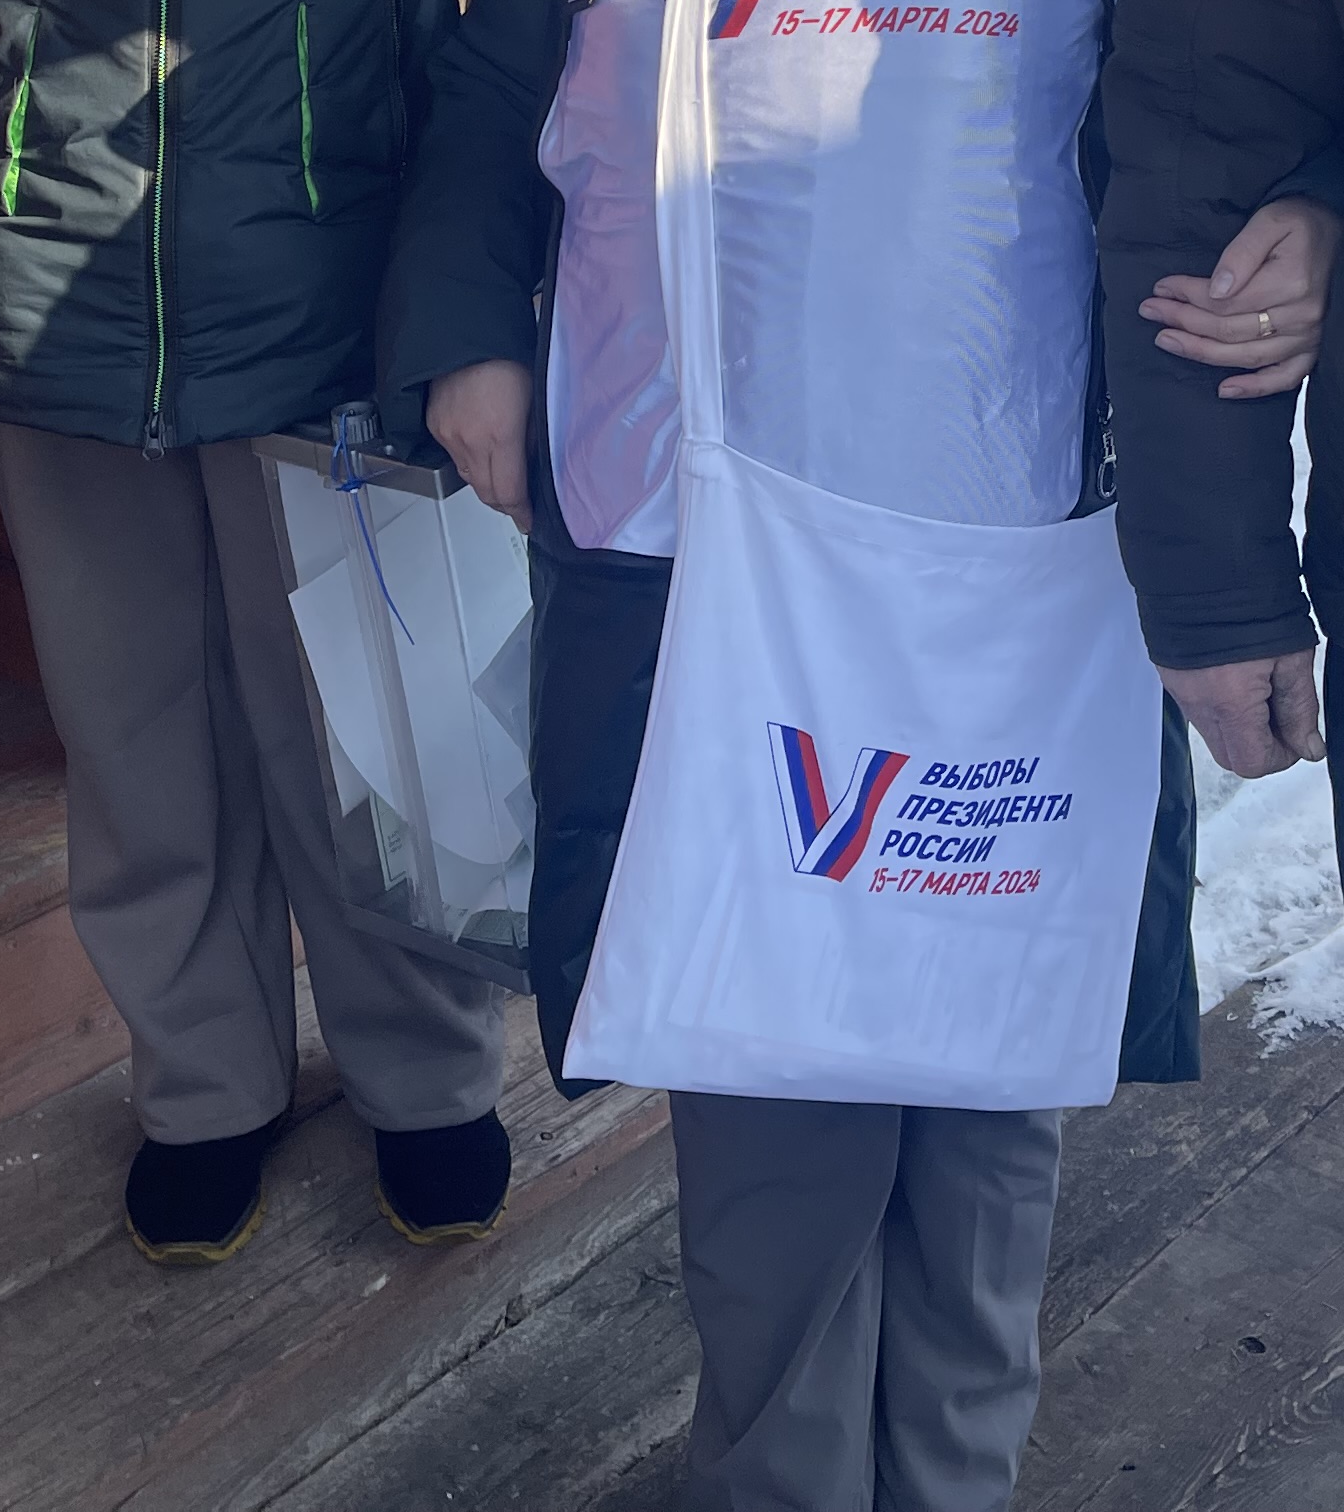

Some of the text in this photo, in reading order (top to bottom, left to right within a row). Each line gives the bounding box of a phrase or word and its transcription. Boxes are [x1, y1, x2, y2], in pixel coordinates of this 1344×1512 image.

[851, 7, 951, 34] МАРТА
[953, 10, 1020, 38] 2024
[919, 757, 1040, 790] ВЫБОРЫ
[896, 793, 1073, 829] ПРЕЗИДЕНТА
[879, 829, 997, 863] РОССИИ
[920, 869, 989, 896] МАРТА
[991, 868, 1041, 894] 2024
